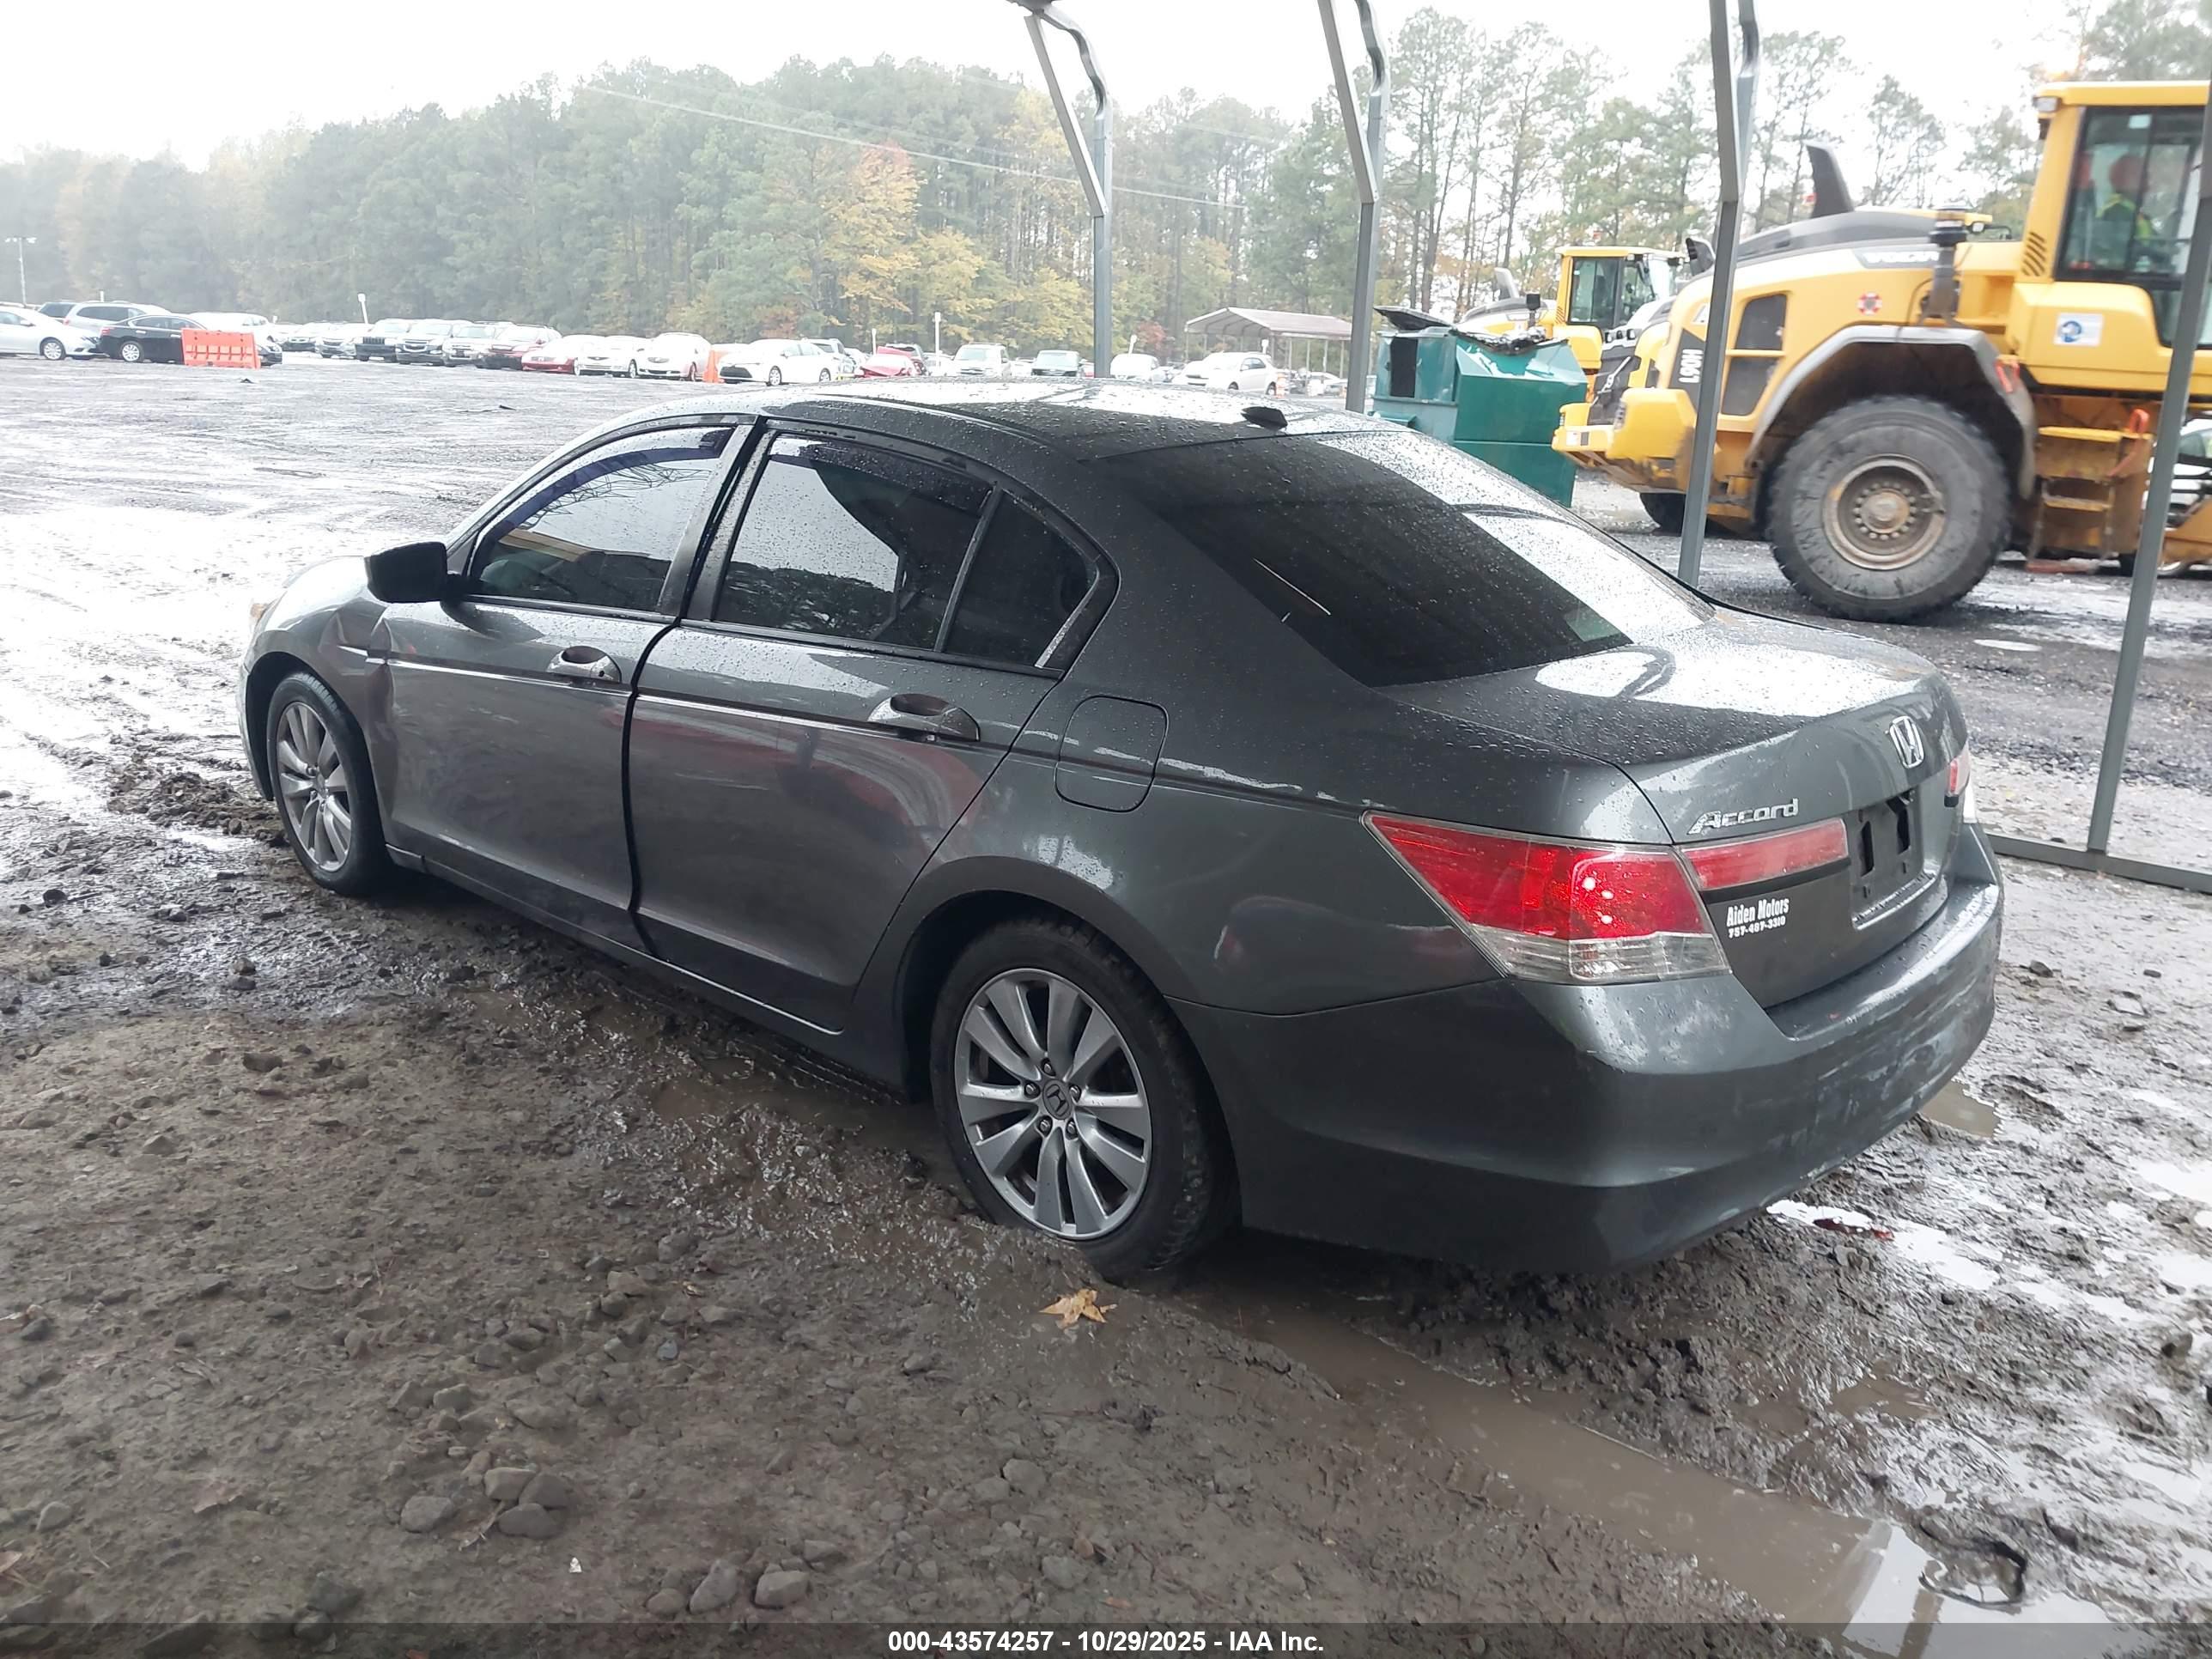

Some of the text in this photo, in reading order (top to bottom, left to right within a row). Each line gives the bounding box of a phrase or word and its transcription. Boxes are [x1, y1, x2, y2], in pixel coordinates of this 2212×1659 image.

[1687, 798, 1799, 835] Accord
[1726, 898, 1790, 927] Aiden Motors
